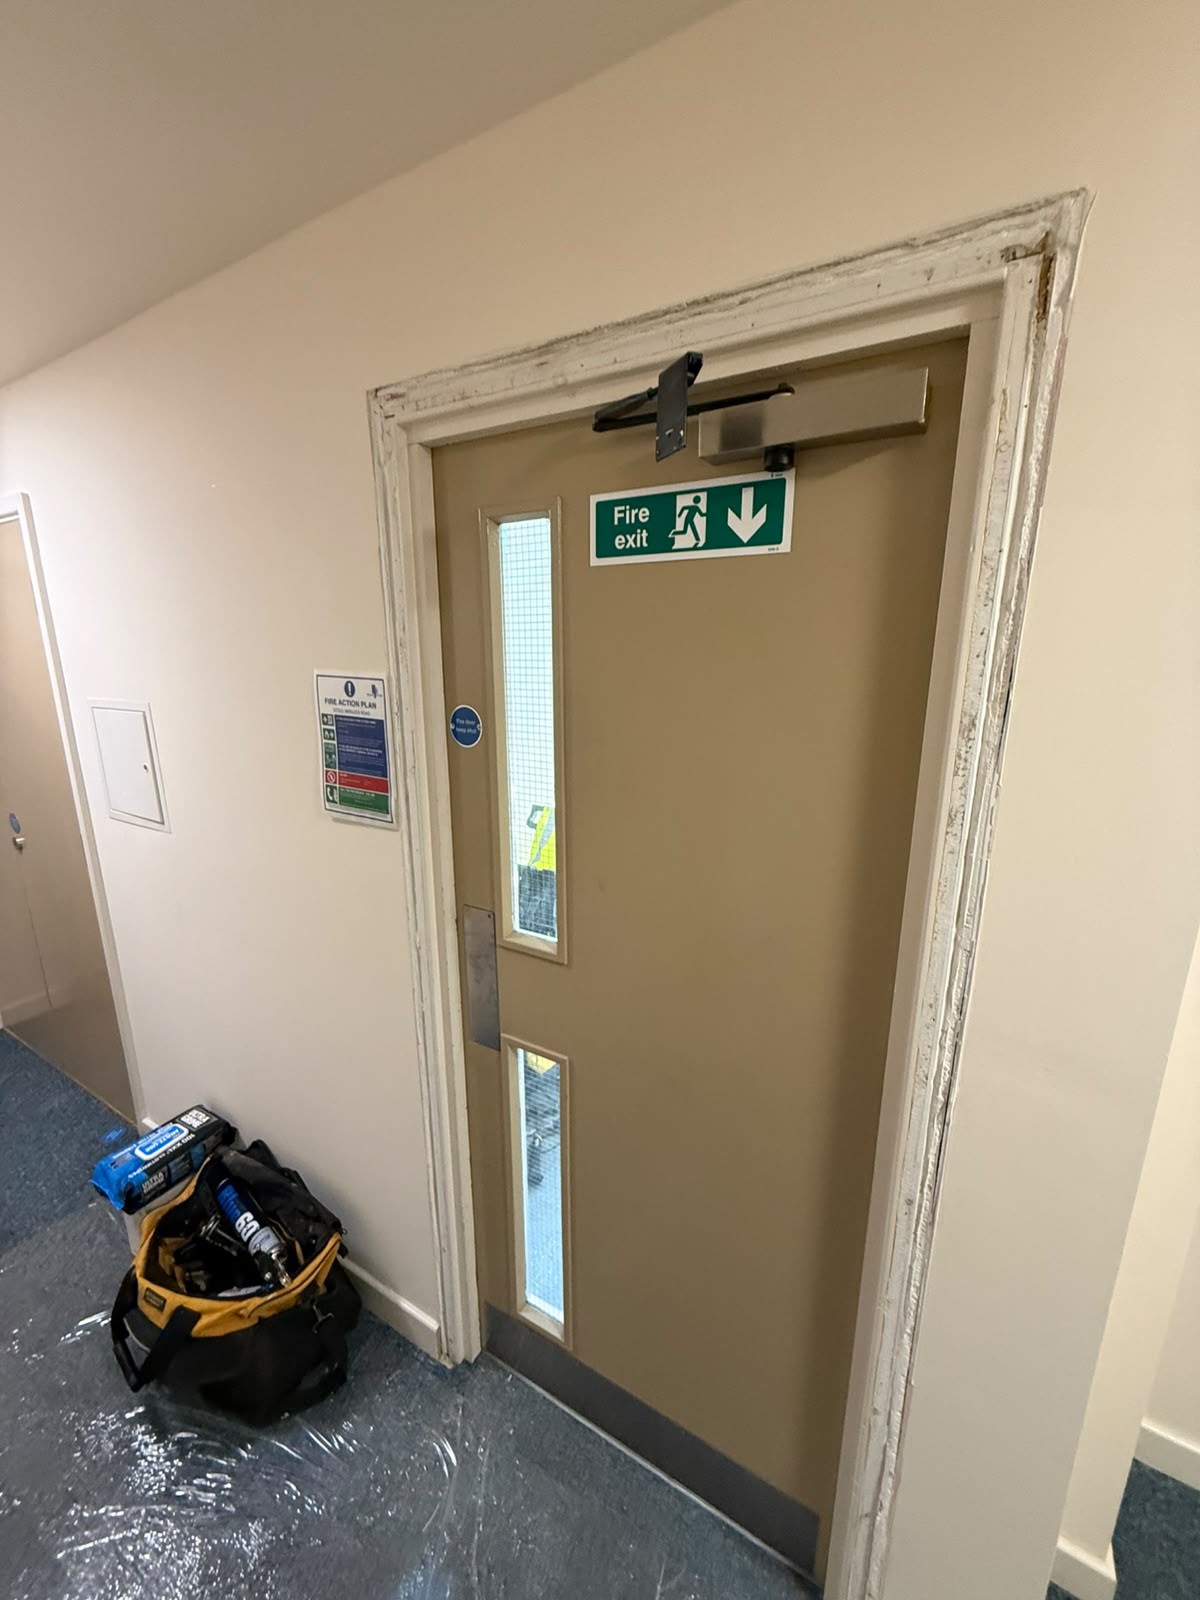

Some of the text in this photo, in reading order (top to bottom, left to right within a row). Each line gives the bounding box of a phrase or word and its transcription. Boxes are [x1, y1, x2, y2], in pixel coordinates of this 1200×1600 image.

[613, 505, 650, 526] Fire
[614, 528, 649, 550] exit
[324, 697, 377, 710] FIRE ACTION PLAN
[235, 1211, 260, 1242] 60
